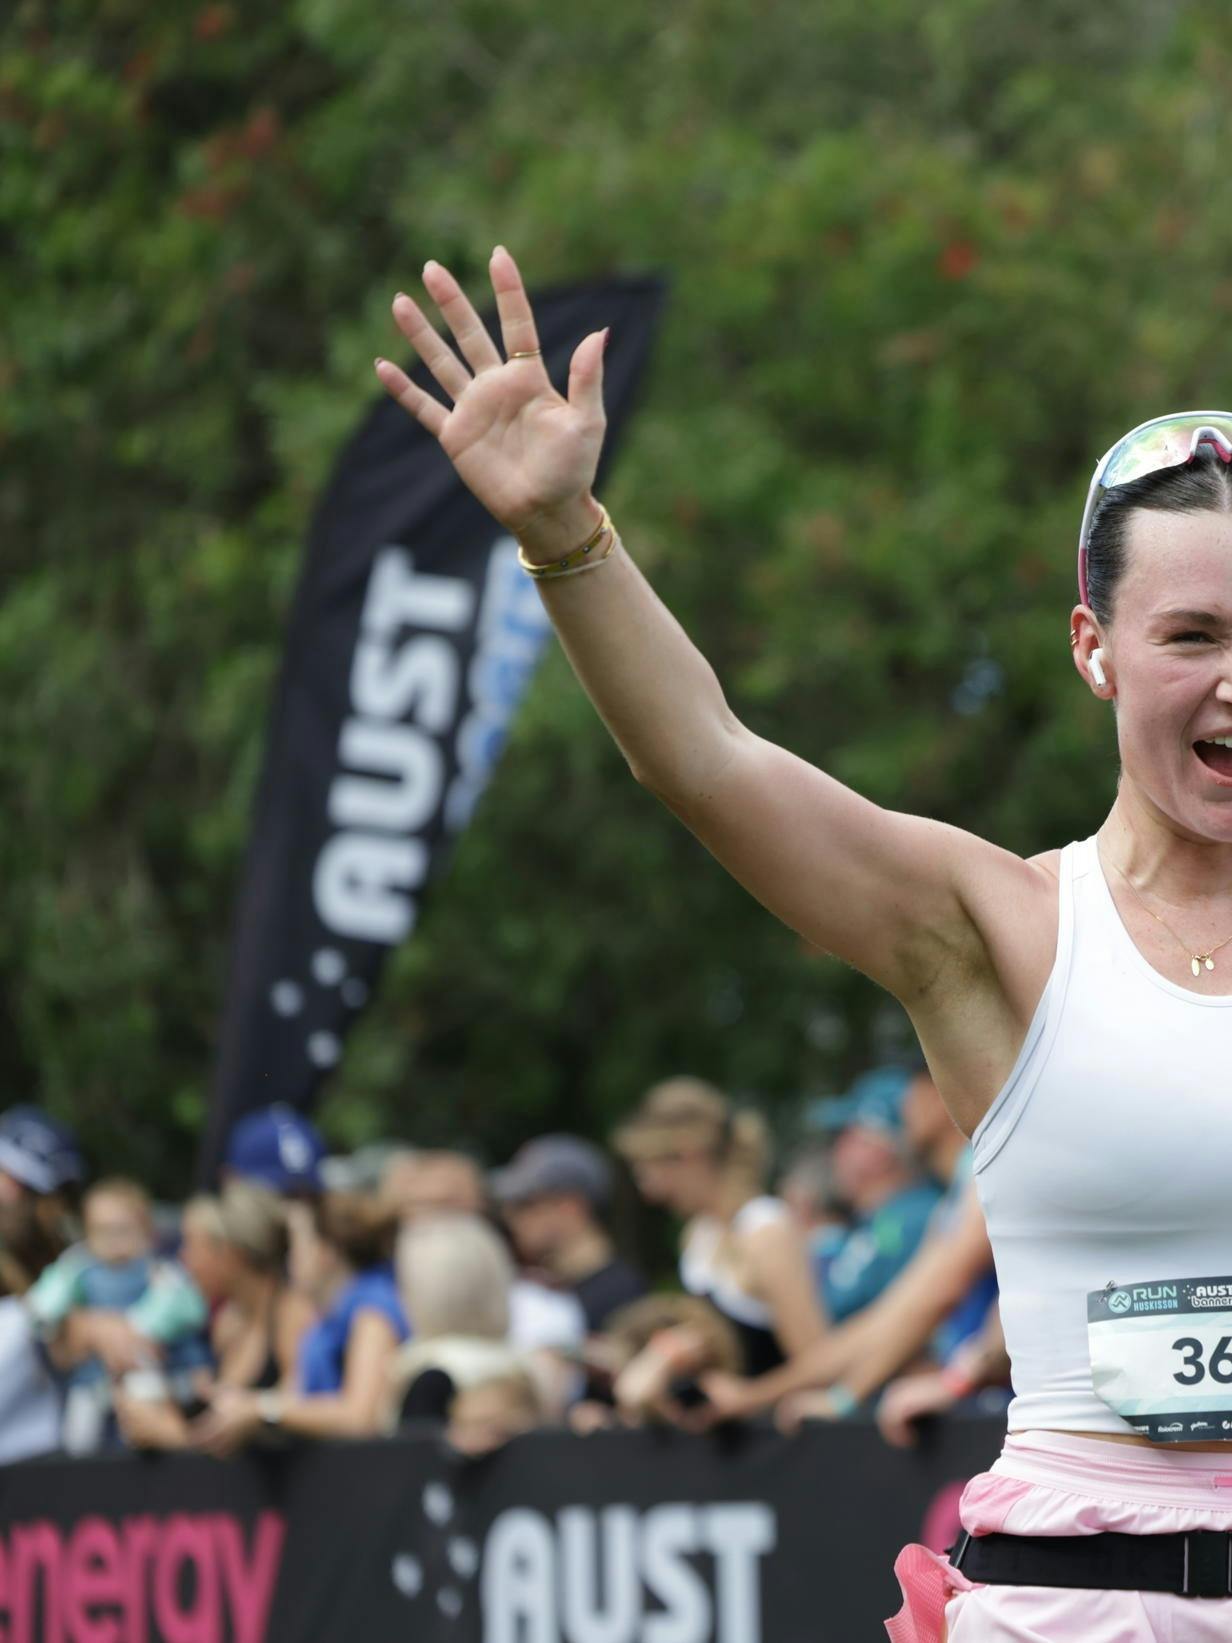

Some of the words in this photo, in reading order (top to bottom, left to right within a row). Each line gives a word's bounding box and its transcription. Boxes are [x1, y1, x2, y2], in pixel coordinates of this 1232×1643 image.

[312, 543, 475, 945] AUST
[1133, 1286, 1177, 1301] RUN
[1134, 1299, 1178, 1311] HUSKISSON
[0, 1508, 288, 1643] nergy
[480, 1501, 777, 1643] AUST
